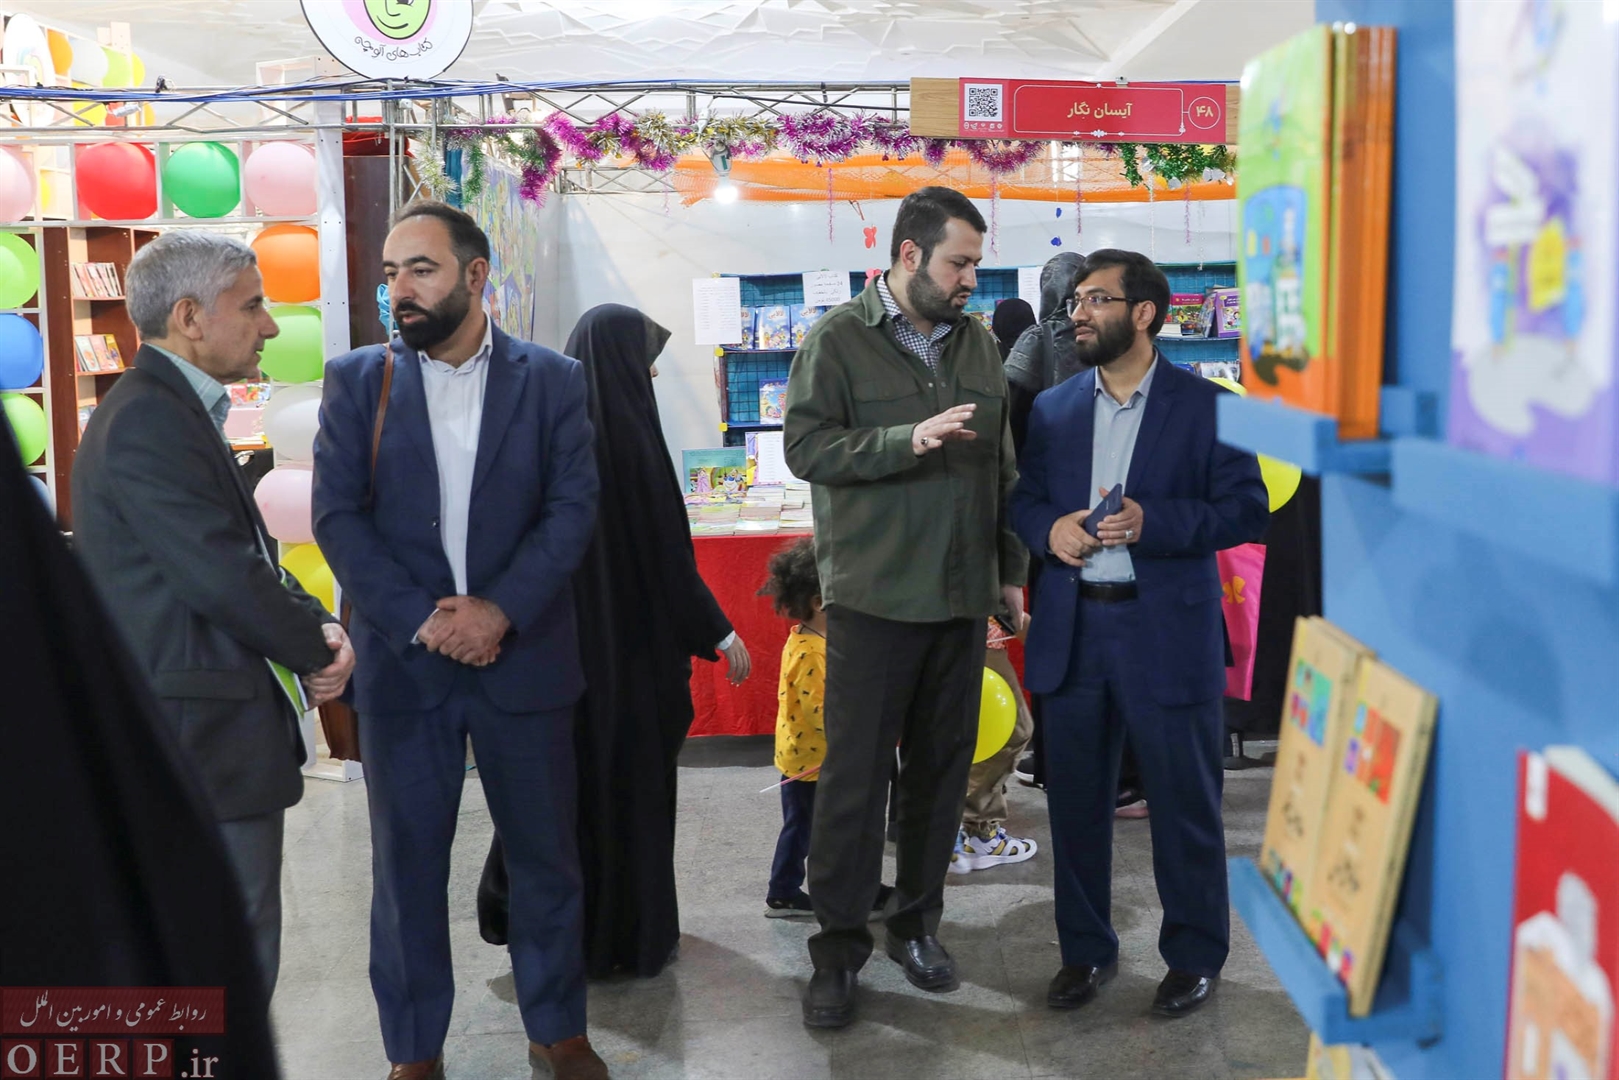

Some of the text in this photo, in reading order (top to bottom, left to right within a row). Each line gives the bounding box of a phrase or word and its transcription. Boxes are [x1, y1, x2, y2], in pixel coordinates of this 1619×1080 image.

[1066, 101, 1133, 119] آیسان نگار
[1196, 105, 1214, 117] ۴۸
